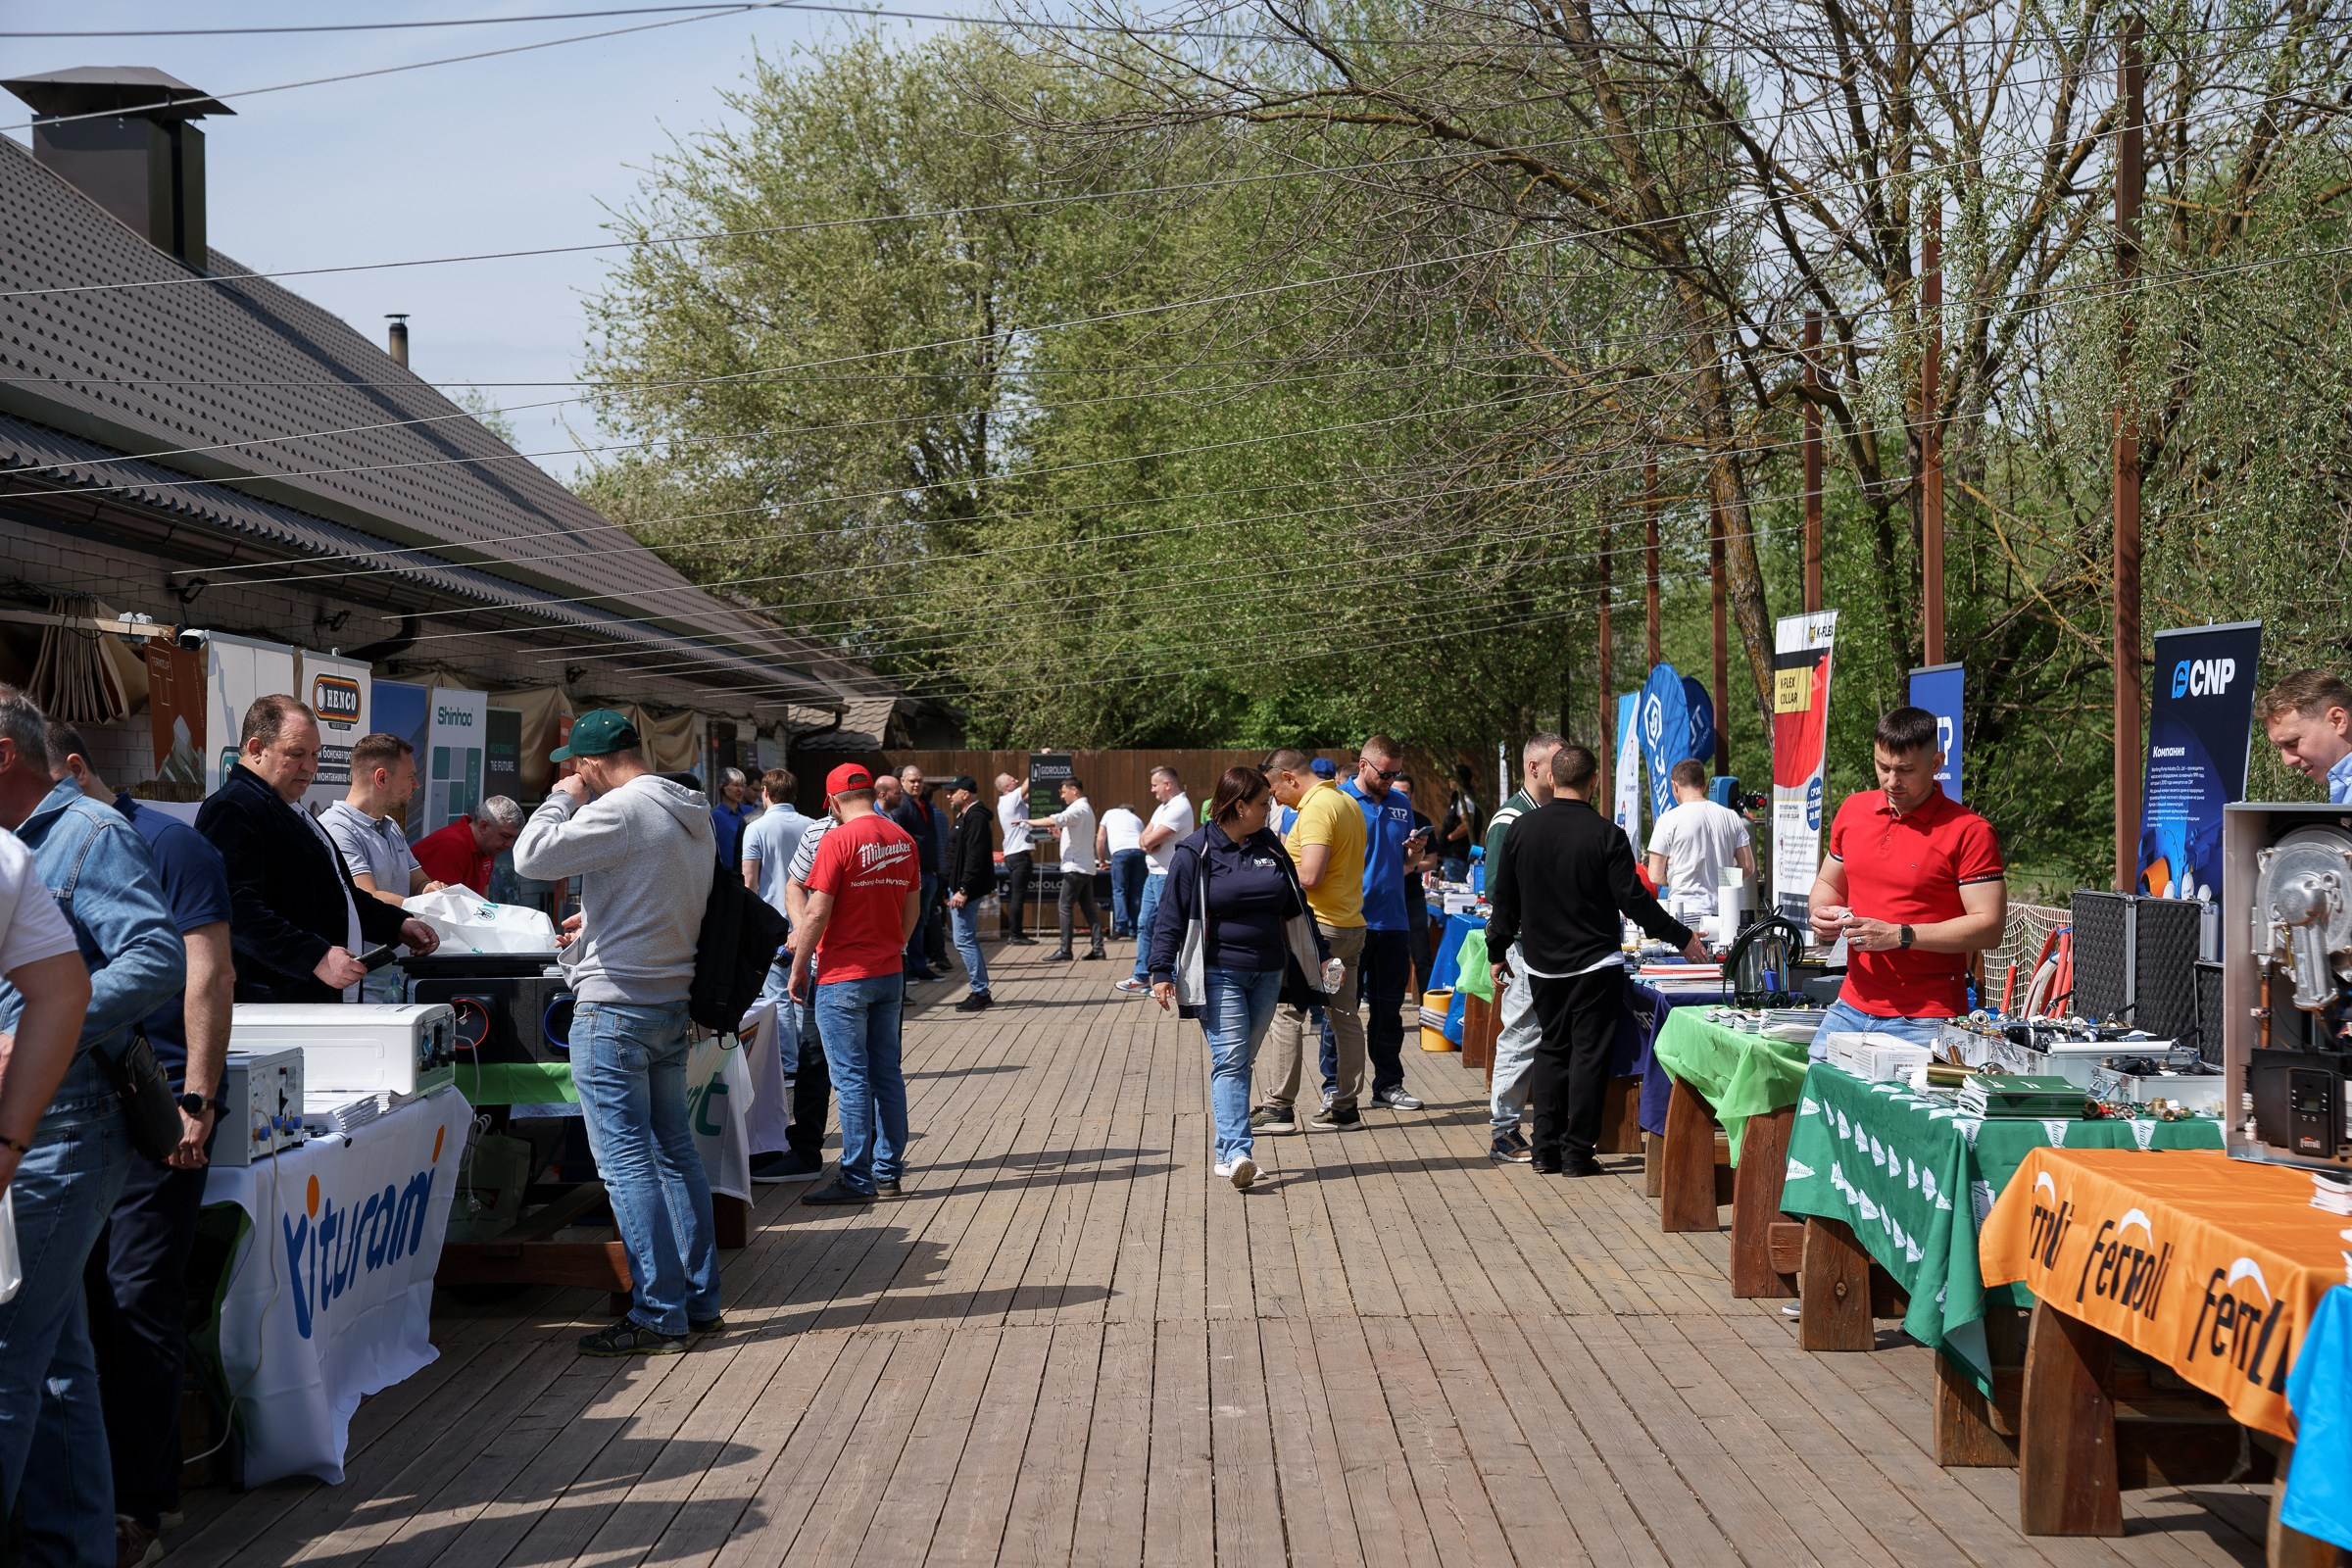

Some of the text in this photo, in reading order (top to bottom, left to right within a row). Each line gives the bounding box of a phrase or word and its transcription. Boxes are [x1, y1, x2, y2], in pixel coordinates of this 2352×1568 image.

[2189, 659, 2235, 697] CNP
[326, 689, 357, 710] HENCO
[437, 706, 472, 726] Shinhoo
[2152, 746, 2185, 759] Компания
[1388, 807, 1407, 819] RTP
[857, 839, 910, 867] Milwaukee
[2299, 1138, 2321, 1149] Ferroli
[2076, 1219, 2175, 1321] Ferroli
